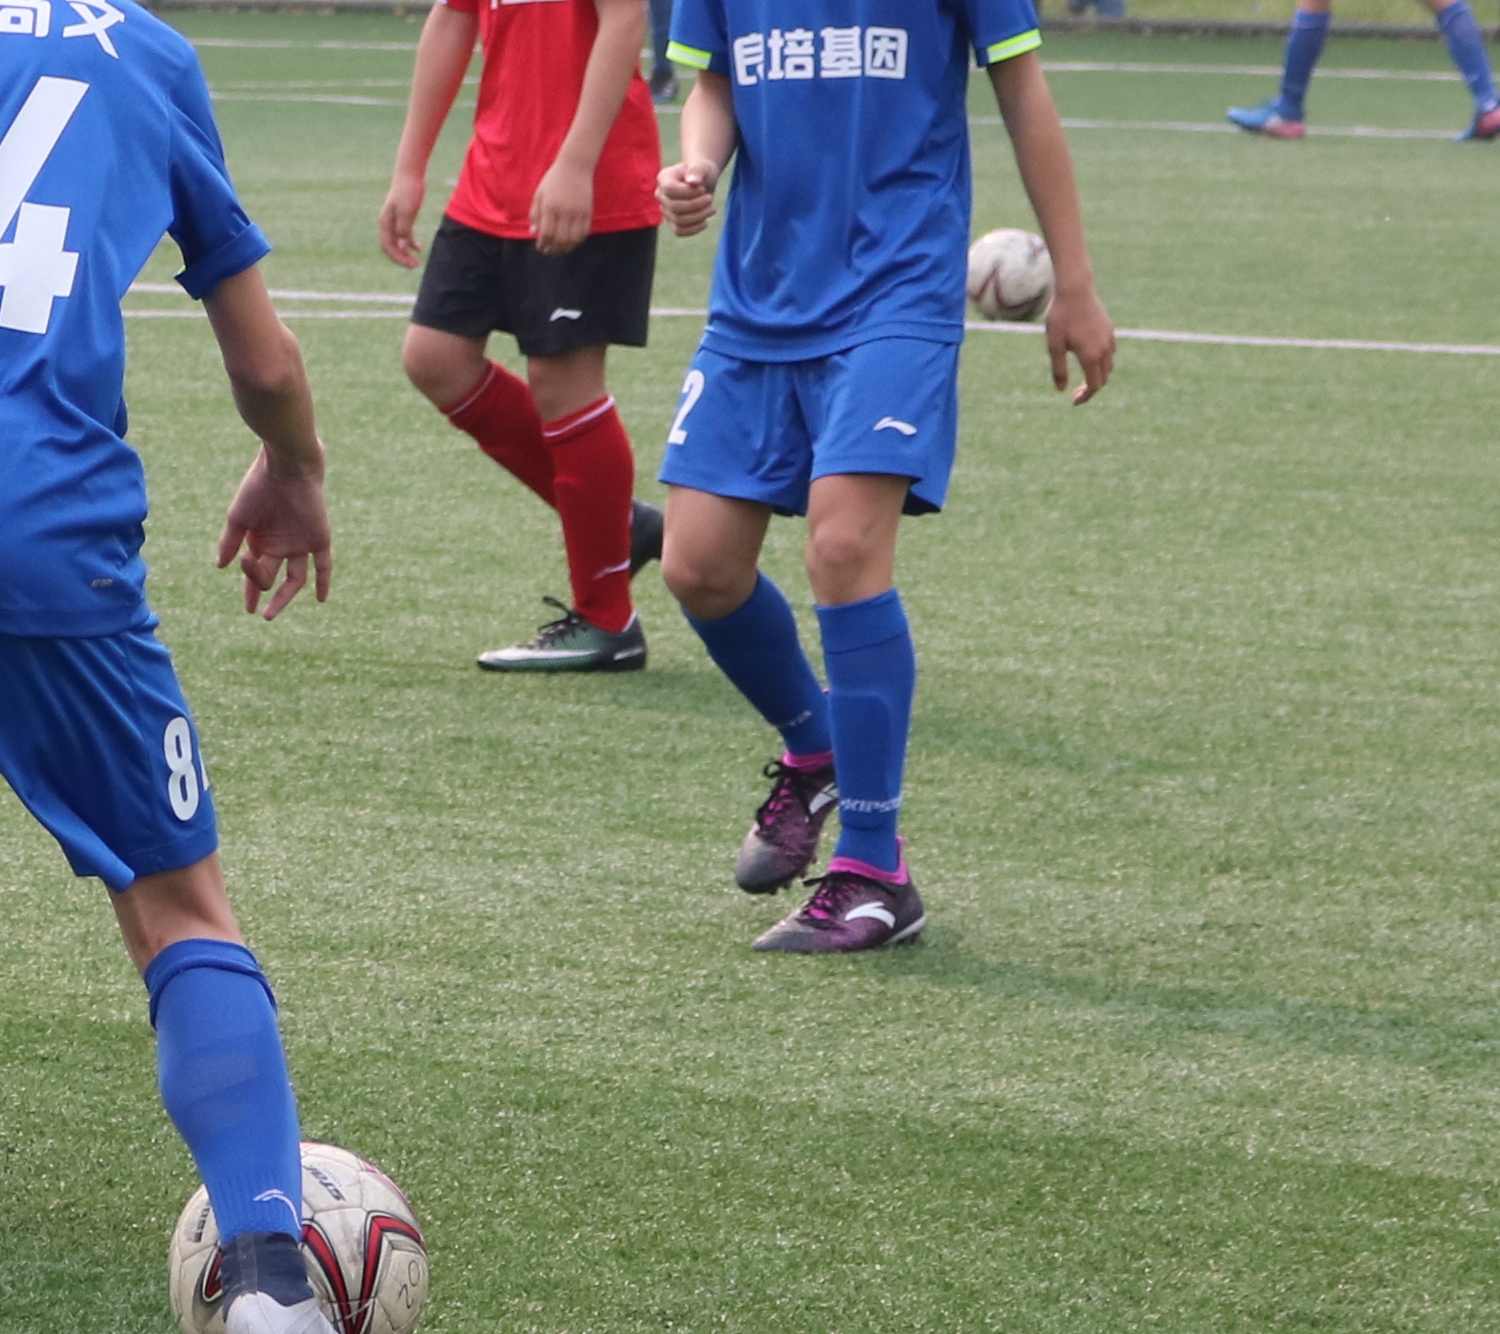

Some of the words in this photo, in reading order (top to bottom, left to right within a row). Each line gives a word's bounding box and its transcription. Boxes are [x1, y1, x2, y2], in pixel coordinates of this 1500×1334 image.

[732, 25, 910, 87] 良培基因
[163, 716, 210, 822] 8
